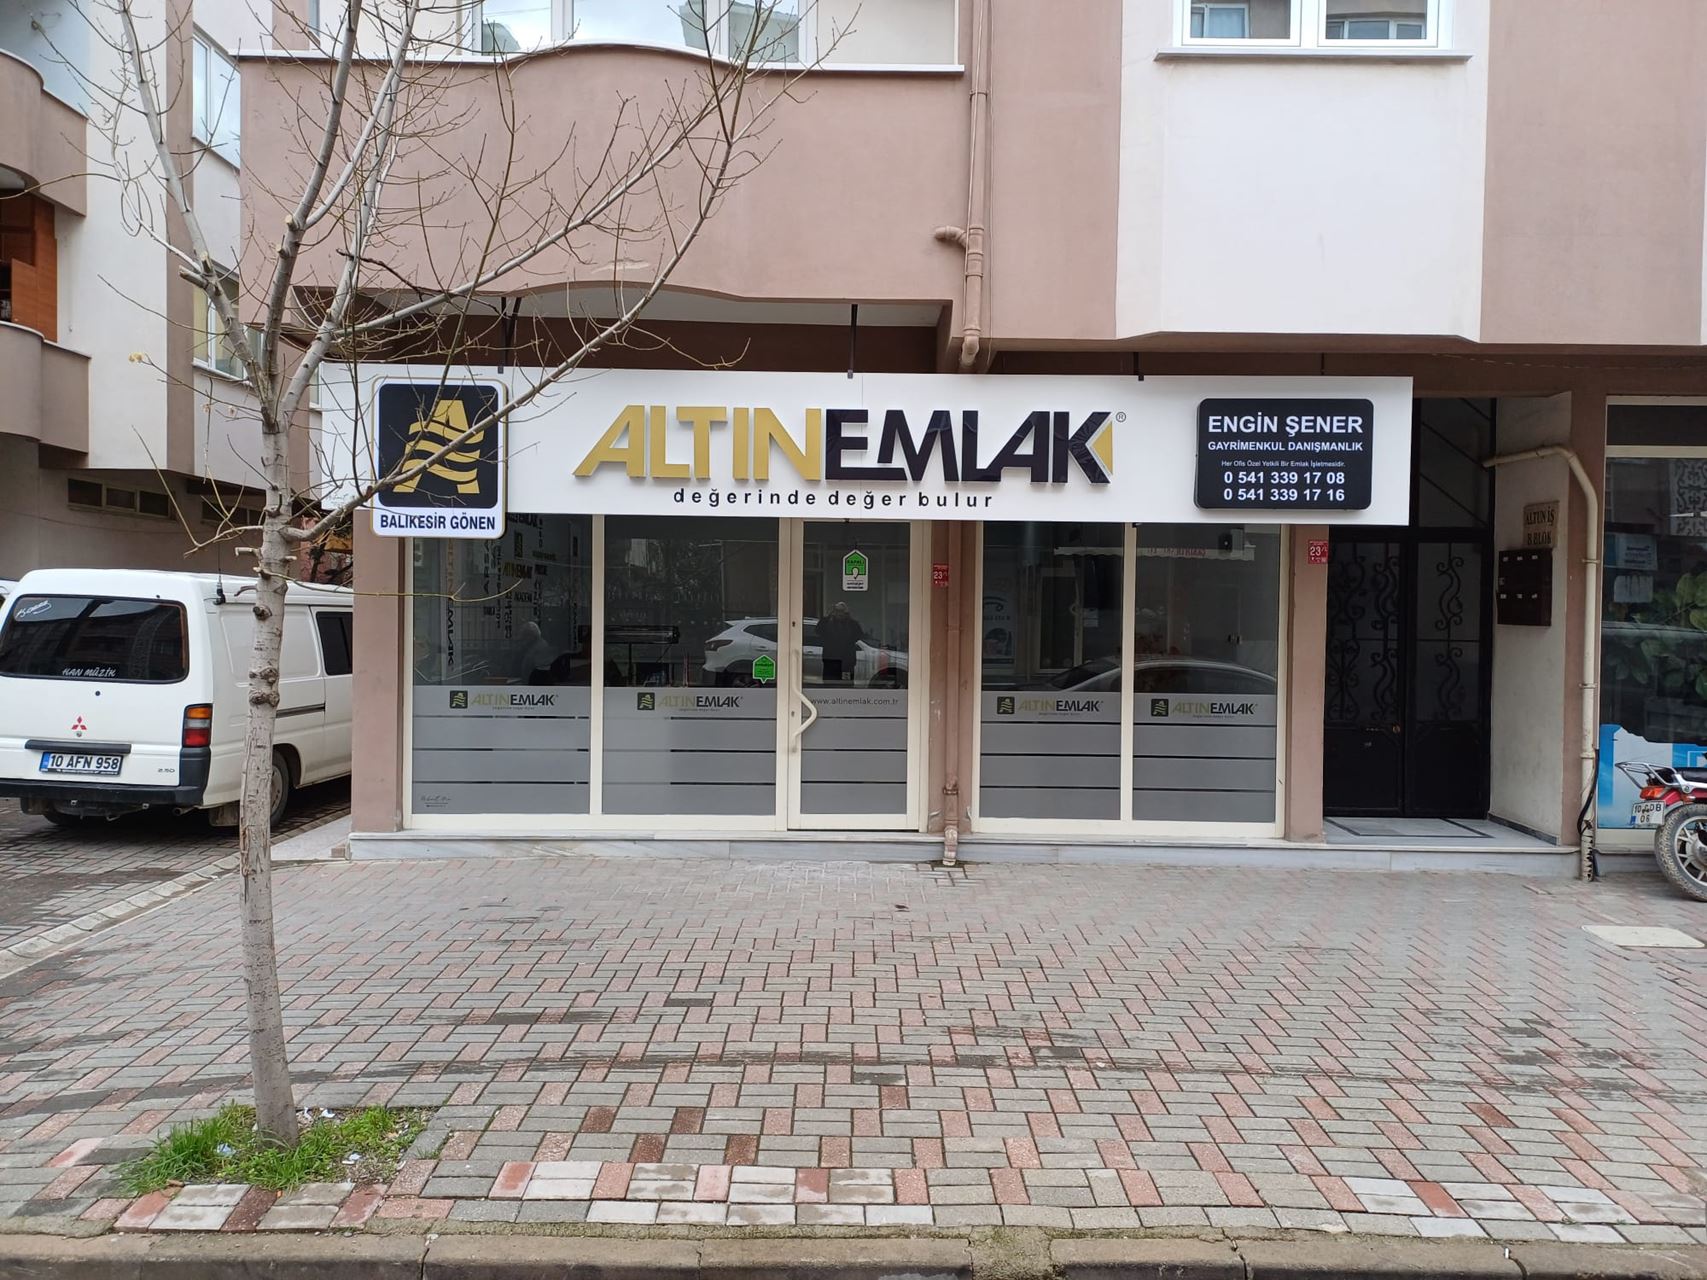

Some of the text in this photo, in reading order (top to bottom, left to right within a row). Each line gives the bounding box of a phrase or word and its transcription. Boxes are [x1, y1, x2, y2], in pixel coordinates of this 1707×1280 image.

[1208, 412, 1363, 437] ENGİN ŞENER
[571, 404, 1112, 484] ALTINEMLAK
[1208, 440, 1363, 453] GAYRİMENKUL DANIŞMANLIK
[1247, 459, 1261, 467] Özel
[1224, 471, 1345, 484] 0 541 339 17 08
[673, 488, 992, 509] değerinde değer bulur
[1223, 488, 1345, 501] 0 541 339 17 16
[380, 511, 446, 529] BALIKESİR
[450, 512, 495, 530] GÖNEN
[471, 693, 555, 706] ALTINEMLAK
[658, 695, 741, 708] ALTINEMLAK
[1018, 699, 1100, 712] ALTINEMLAK
[1172, 702, 1254, 715] ALTINEMLAK
[50, 755, 119, 770] 10 AFN 958
